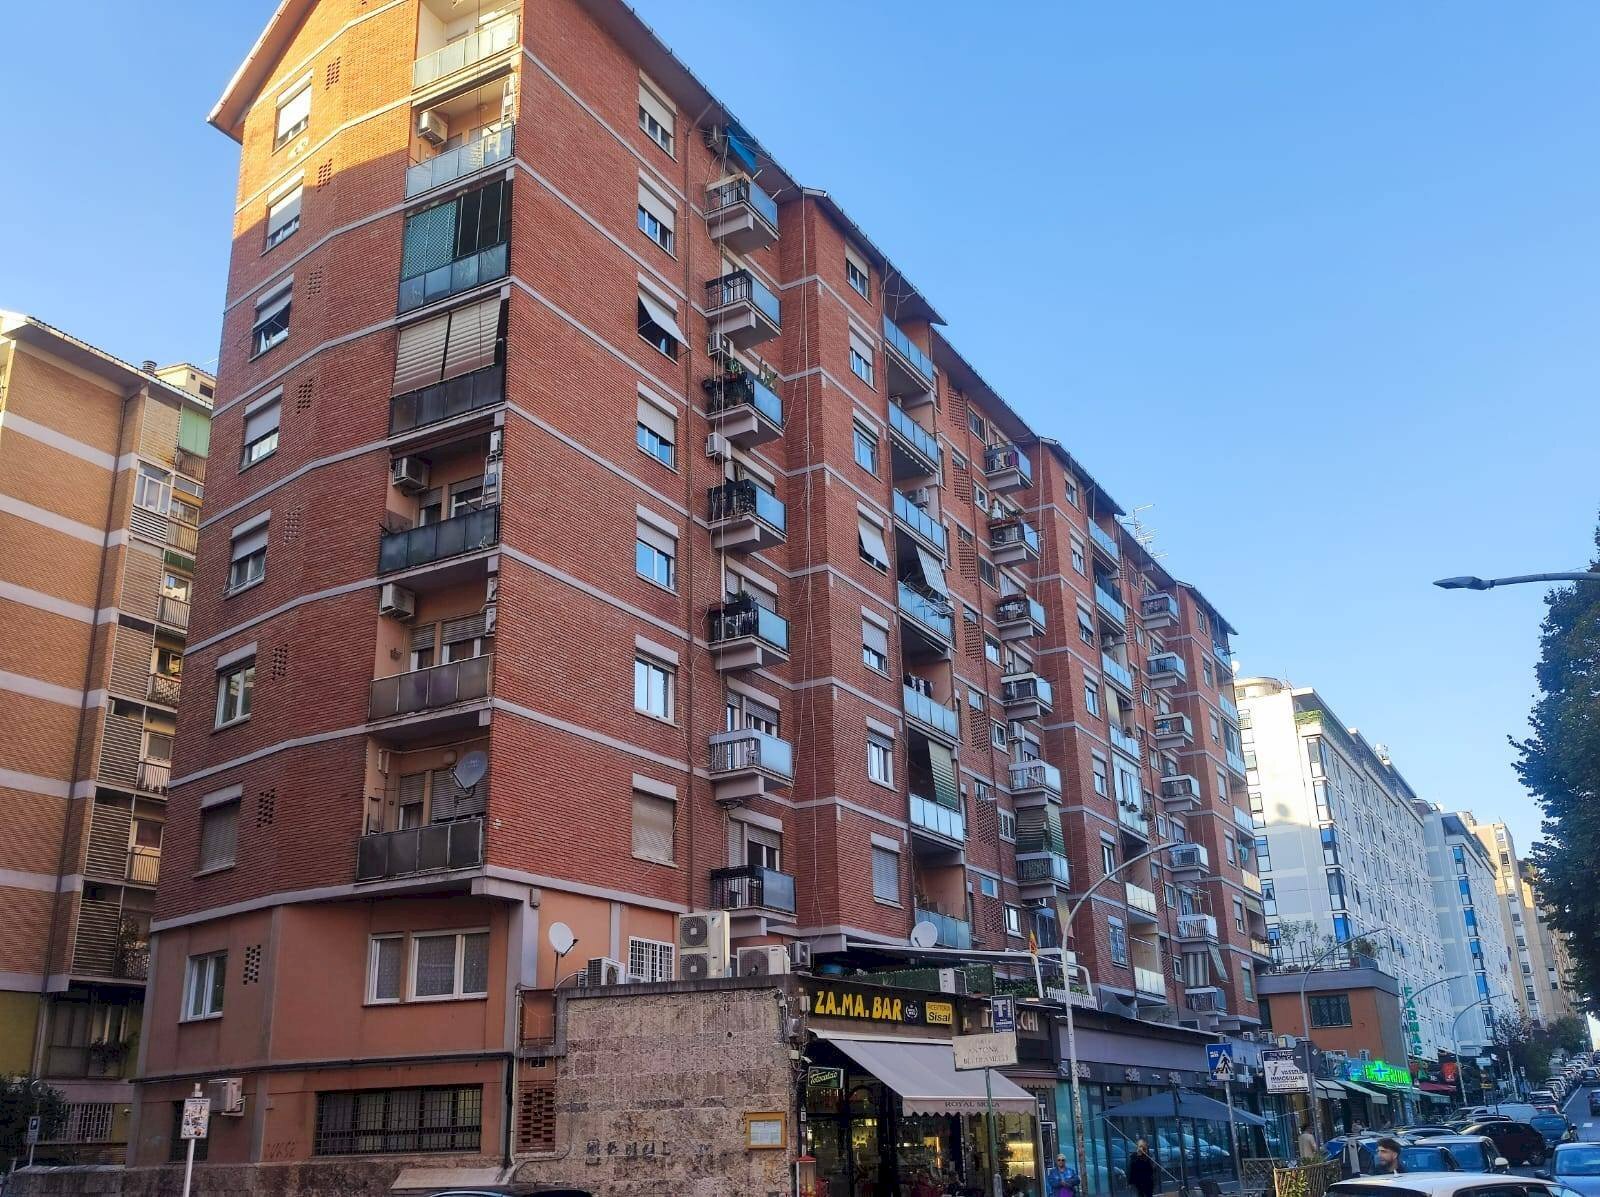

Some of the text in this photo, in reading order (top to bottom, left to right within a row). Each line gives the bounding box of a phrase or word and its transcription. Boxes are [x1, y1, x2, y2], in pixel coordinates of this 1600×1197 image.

[814, 990, 902, 1021] ZA.MA. BAR
[928, 1011, 950, 1022] Sisal
